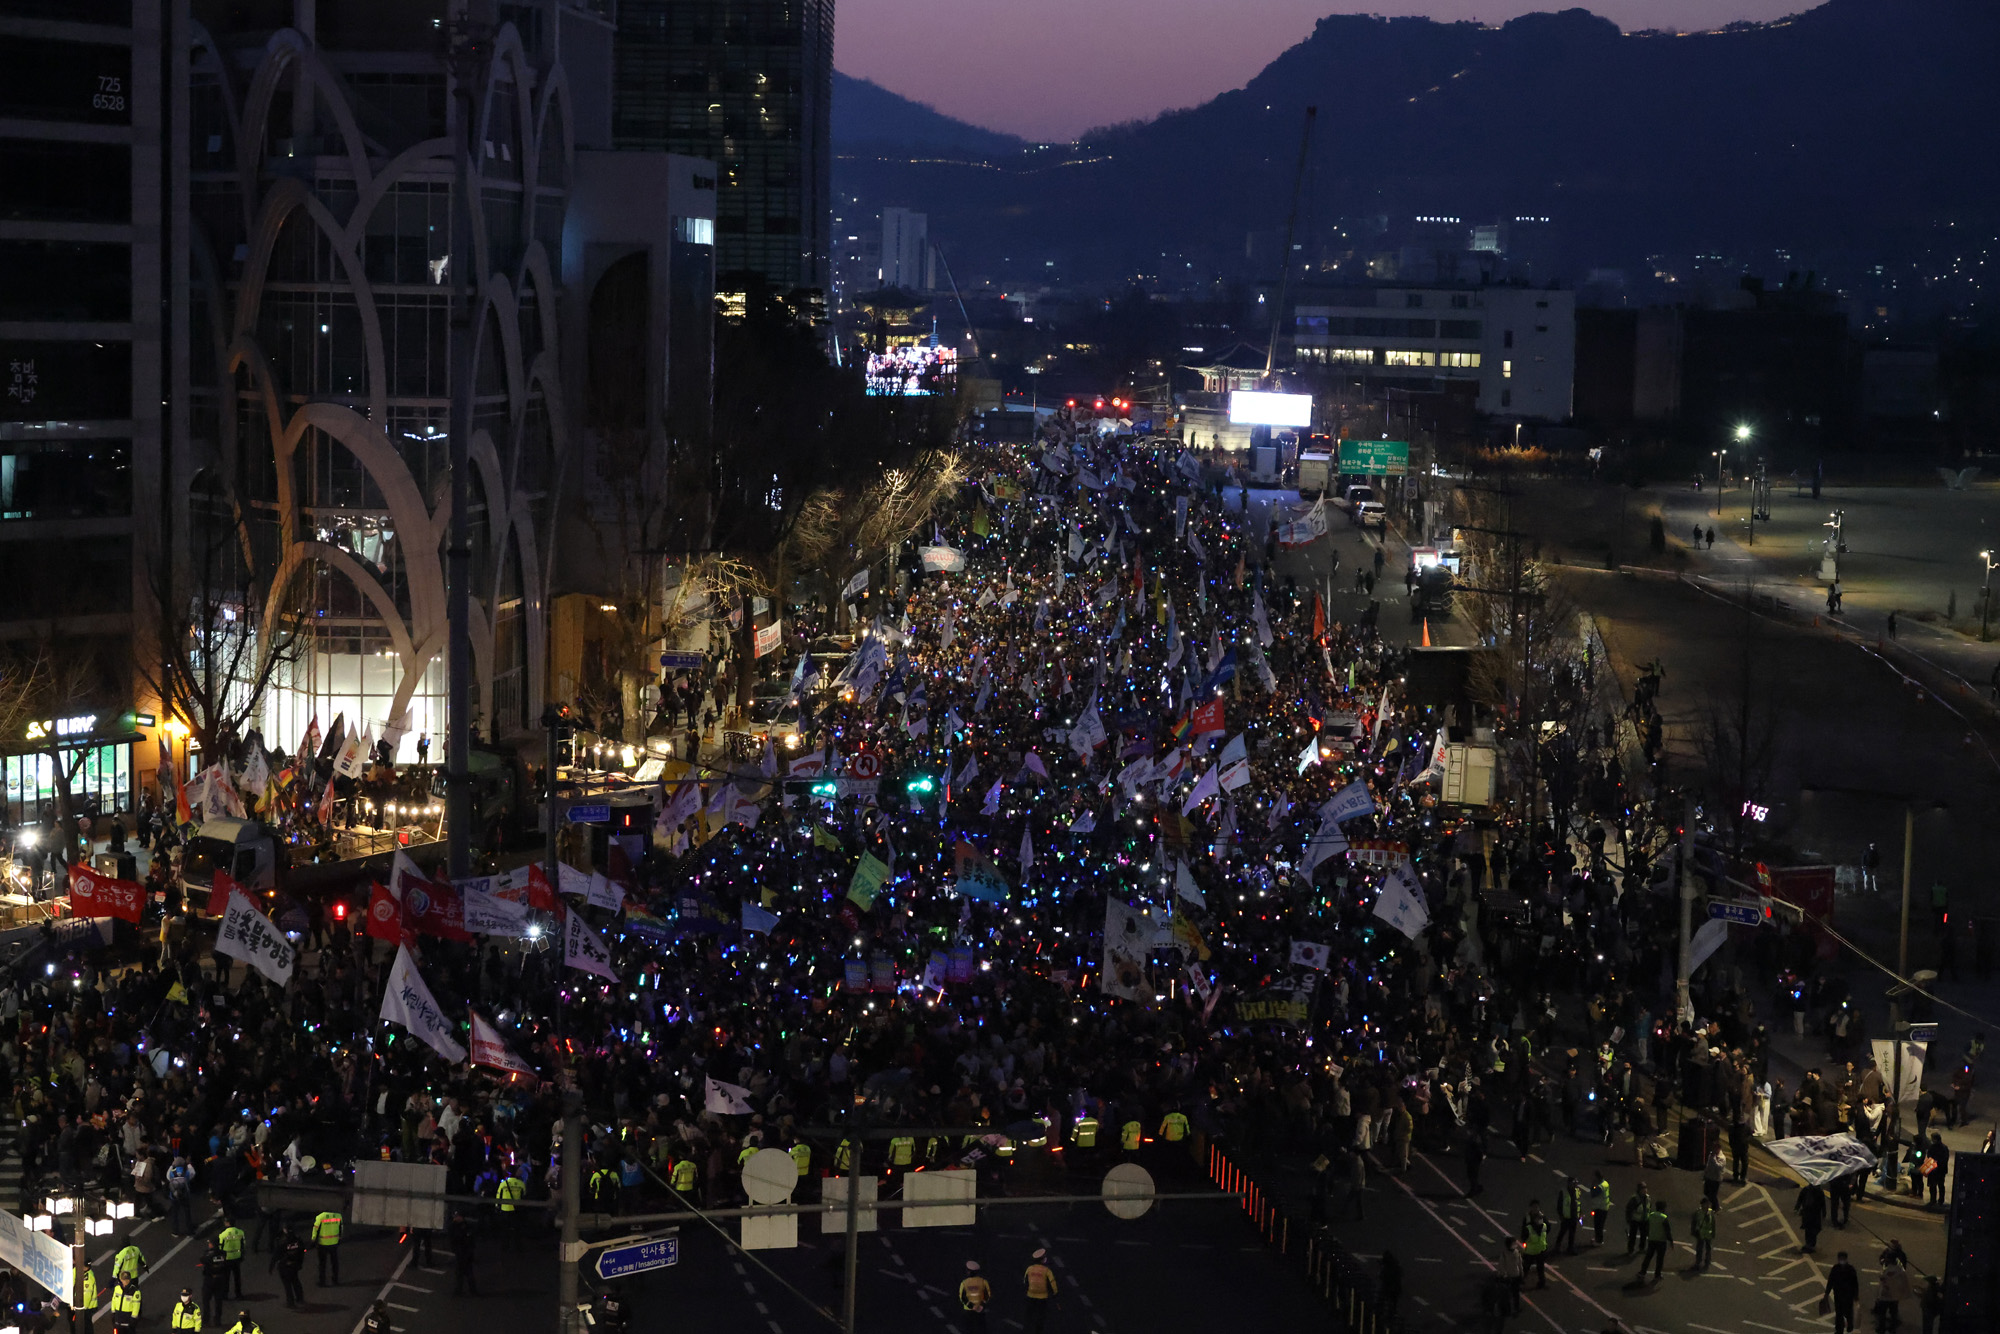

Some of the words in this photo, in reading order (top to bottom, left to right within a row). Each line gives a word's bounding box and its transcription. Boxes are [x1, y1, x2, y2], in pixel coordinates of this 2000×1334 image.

[98, 76, 121, 93] 725
[92, 93, 125, 111] 6528
[9, 358, 39, 384] 참빛
[7, 384, 37, 404] 치과
[641, 1241, 675, 1258] 인사동길
